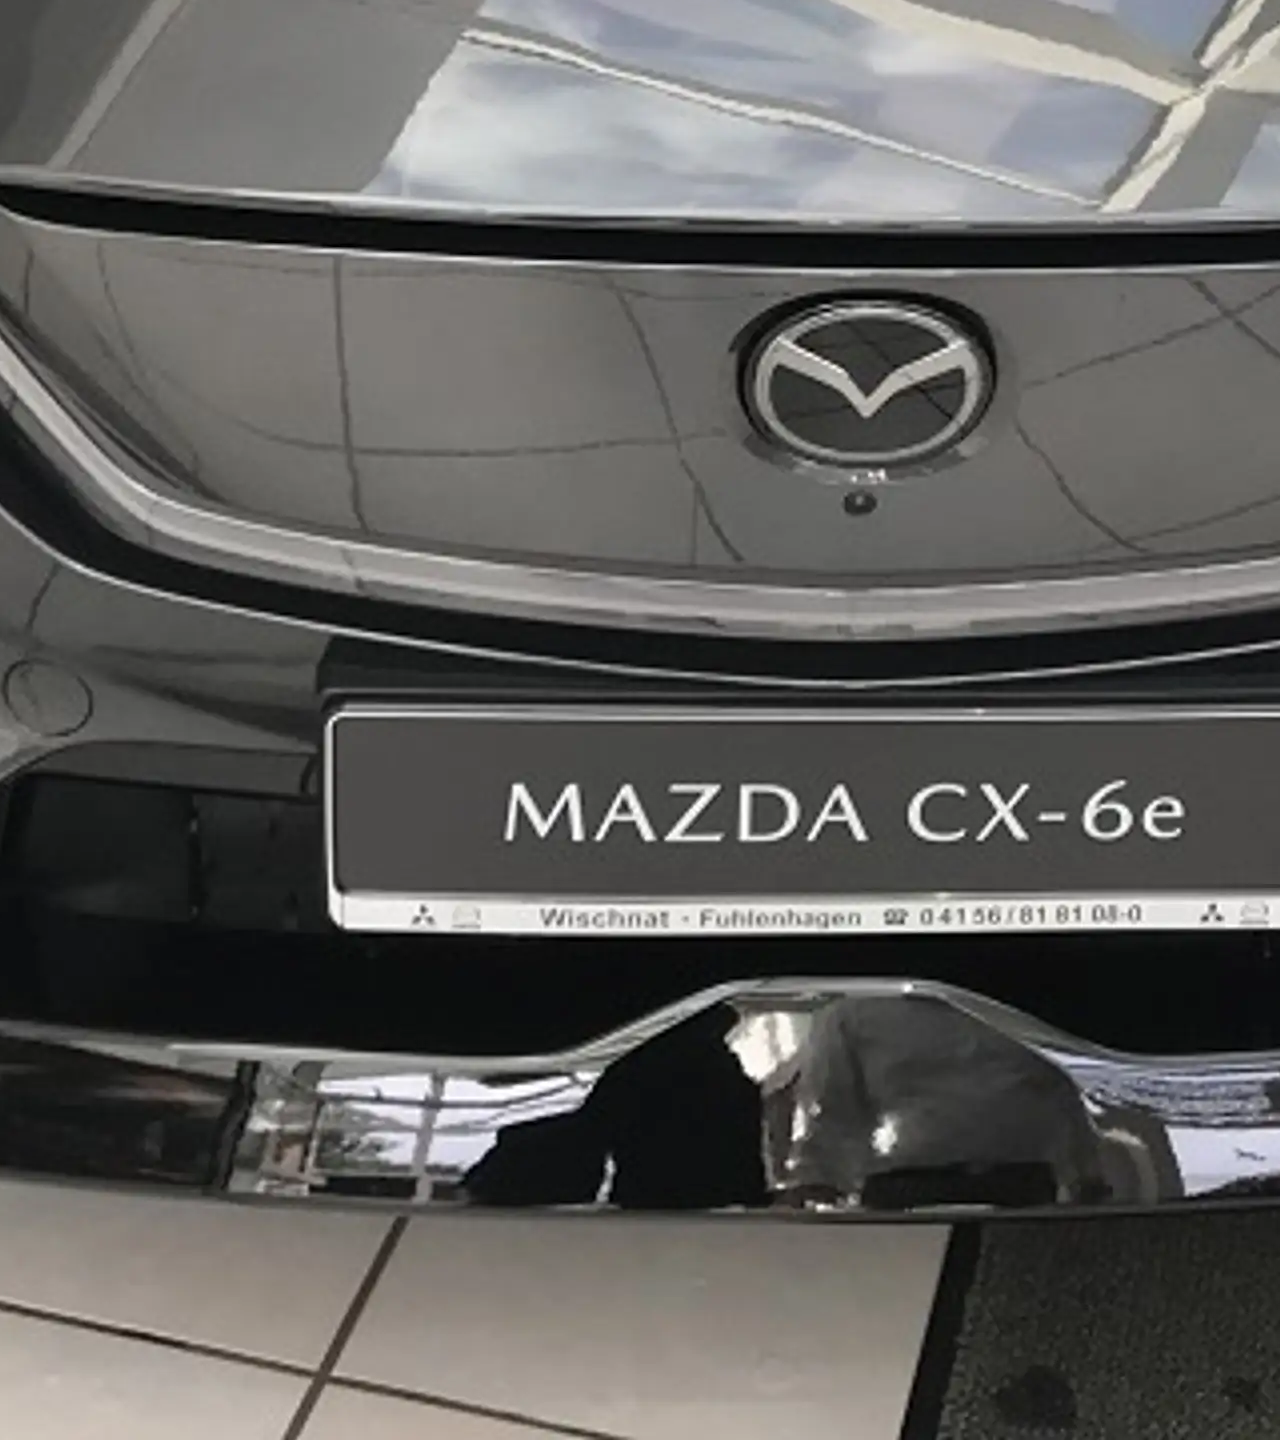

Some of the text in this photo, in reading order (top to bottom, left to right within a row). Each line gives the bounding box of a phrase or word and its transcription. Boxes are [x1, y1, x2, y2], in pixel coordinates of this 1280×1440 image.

[504, 779, 1186, 843] MAZDA CX-6e
[539, 907, 669, 928] Wischnat
[699, 907, 862, 930] Fuhlenhagen
